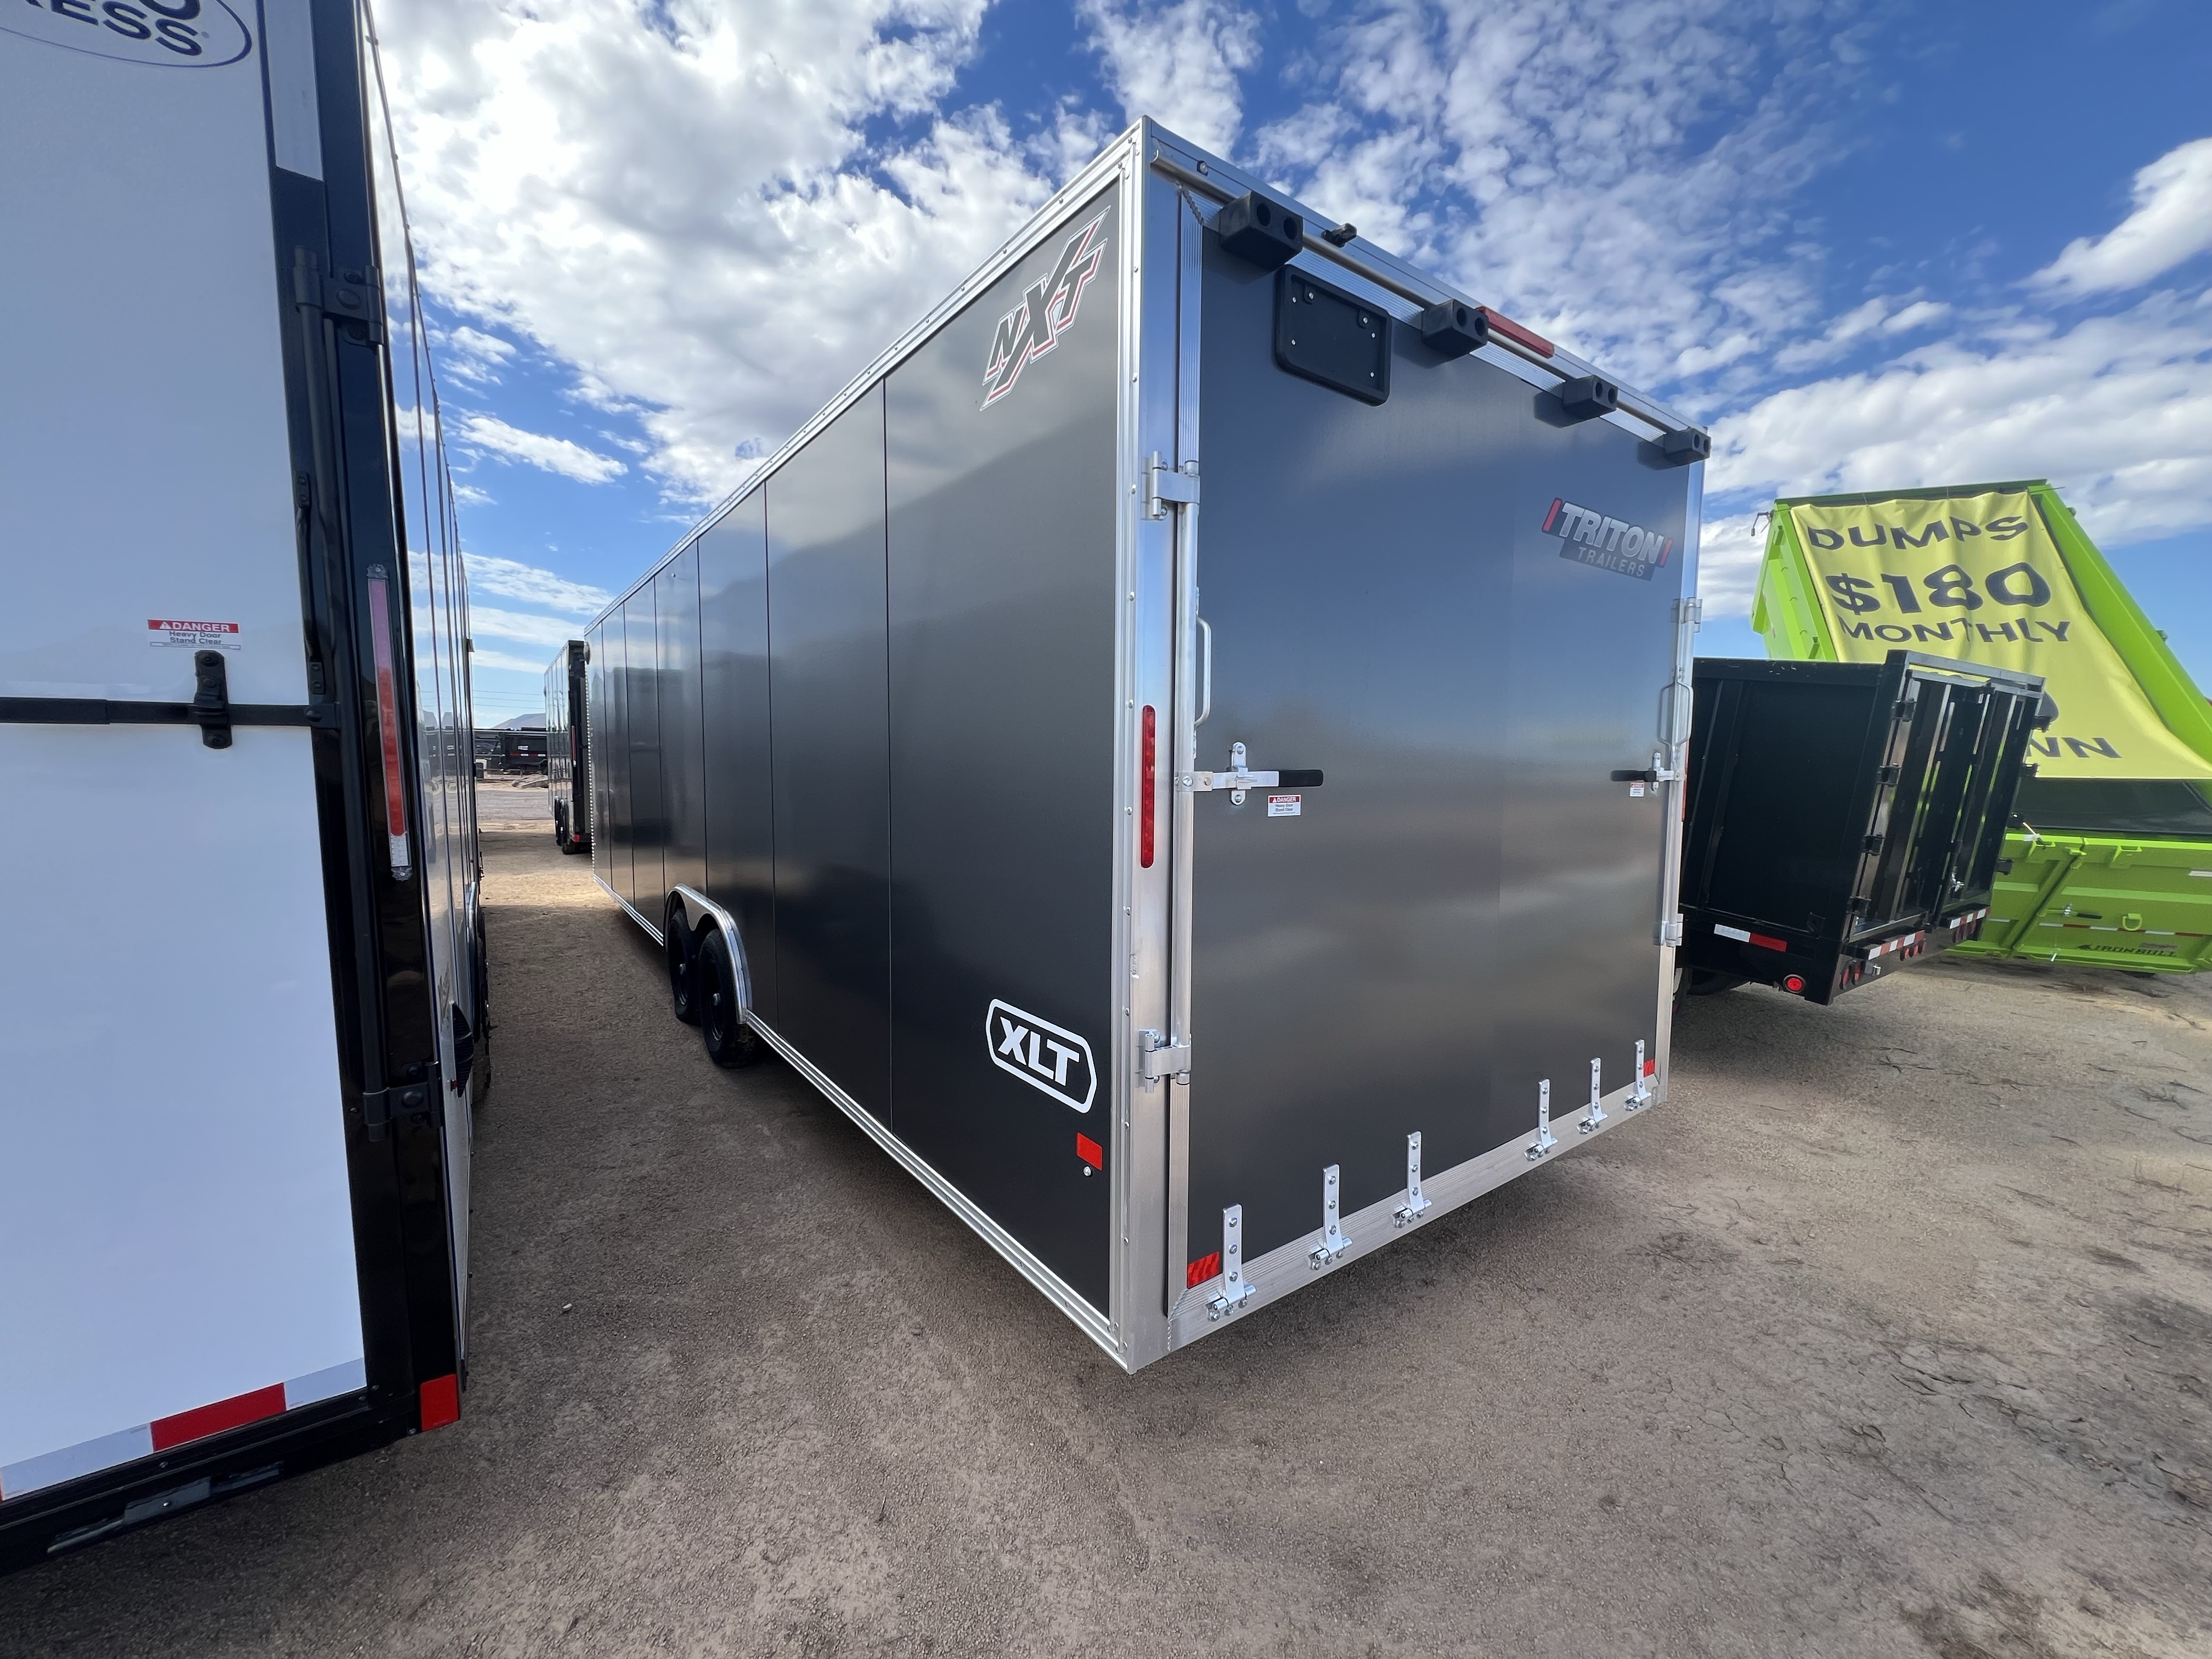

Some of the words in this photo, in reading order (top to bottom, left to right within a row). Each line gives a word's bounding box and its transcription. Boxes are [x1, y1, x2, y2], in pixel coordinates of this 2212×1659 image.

[25, 0, 202, 56] ESS
[1559, 502, 1664, 564] TRITON
[1807, 516, 2028, 550] DUMPS
[1578, 546, 1645, 577] TRAILERS
[1825, 562, 2051, 616] $180
[169, 630, 196, 640] Heavy
[172, 622, 230, 632] DANGER
[1837, 614, 2070, 642] MONTHLY
[2094, 945, 2177, 957] IRONBULL
[998, 1016, 1080, 1086] XLT
